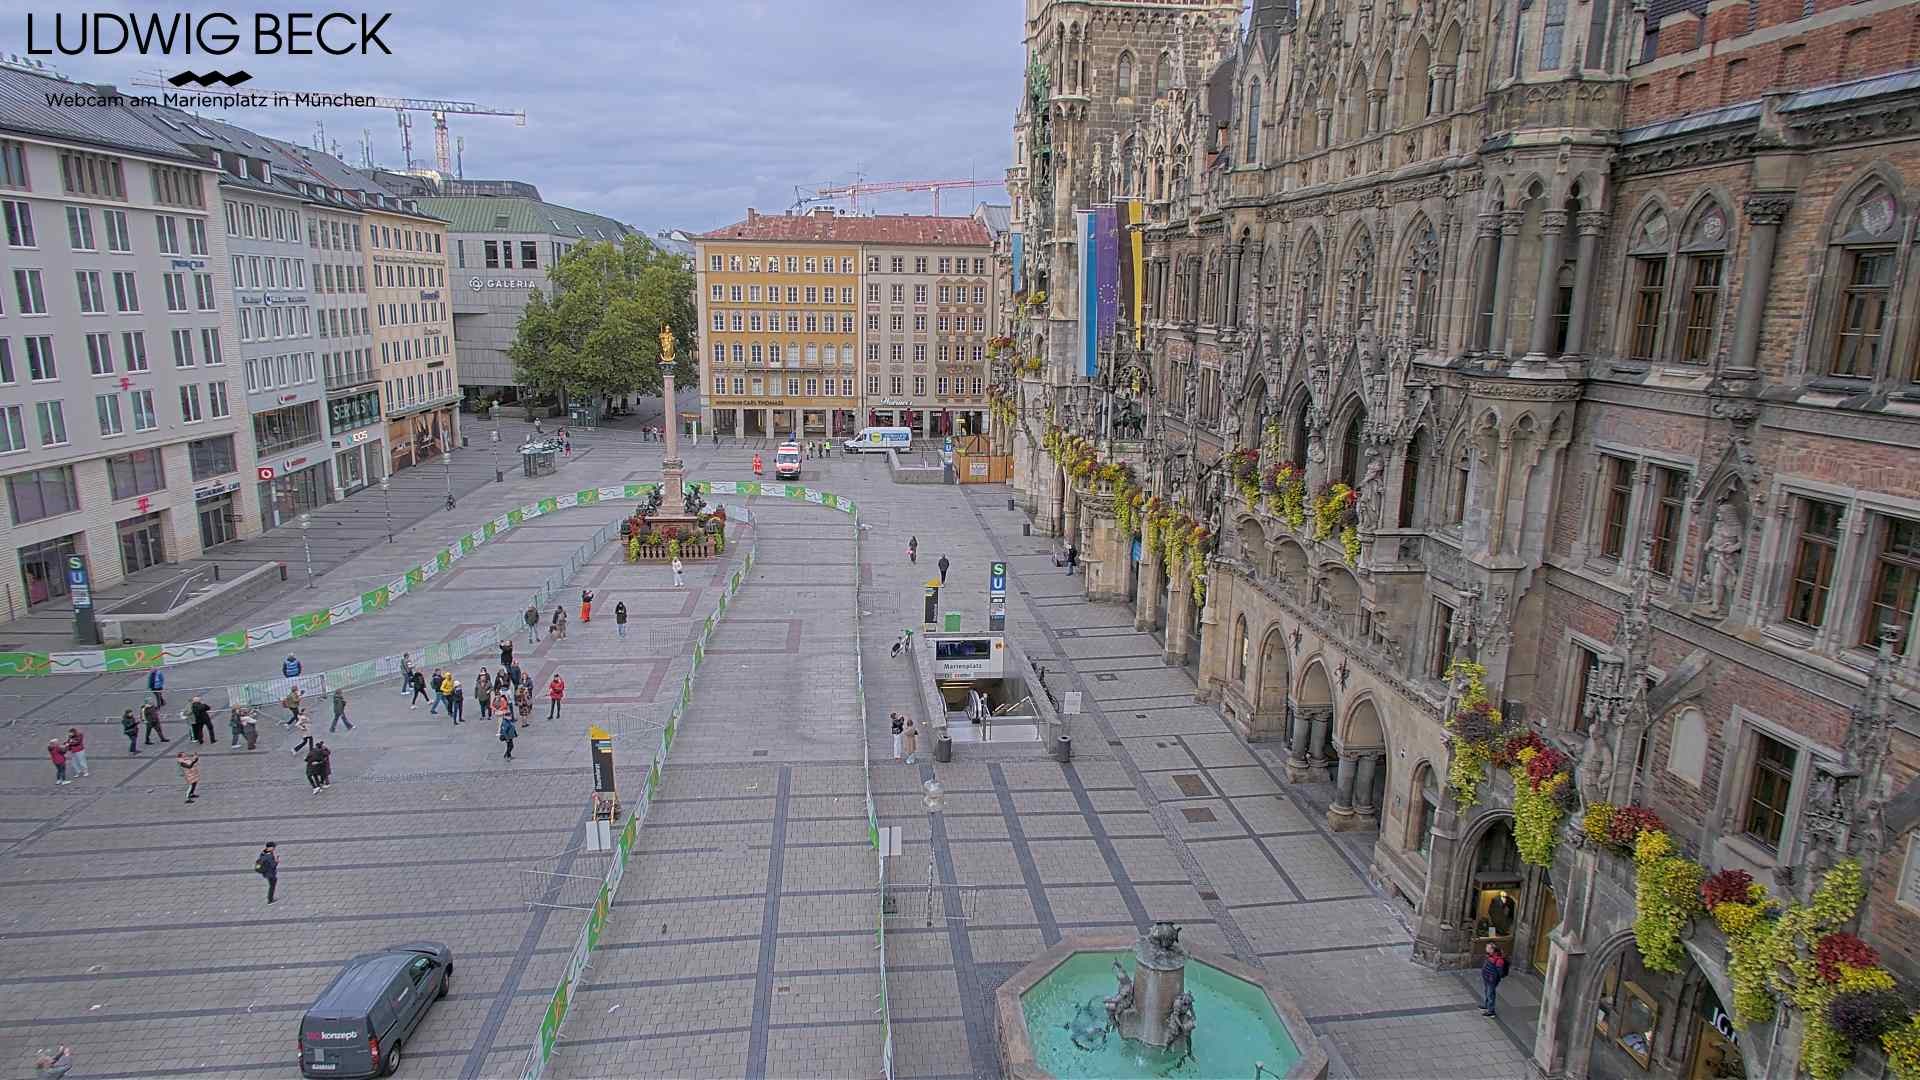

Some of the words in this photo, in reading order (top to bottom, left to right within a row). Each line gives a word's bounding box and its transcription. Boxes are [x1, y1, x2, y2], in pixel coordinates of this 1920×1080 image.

[487, 279, 536, 288] GALERIA
[70, 557, 82, 569] S
[993, 563, 1004, 576] S
[72, 572, 83, 584] U
[993, 577, 1003, 590] U
[944, 662, 982, 671] Marienplatz
